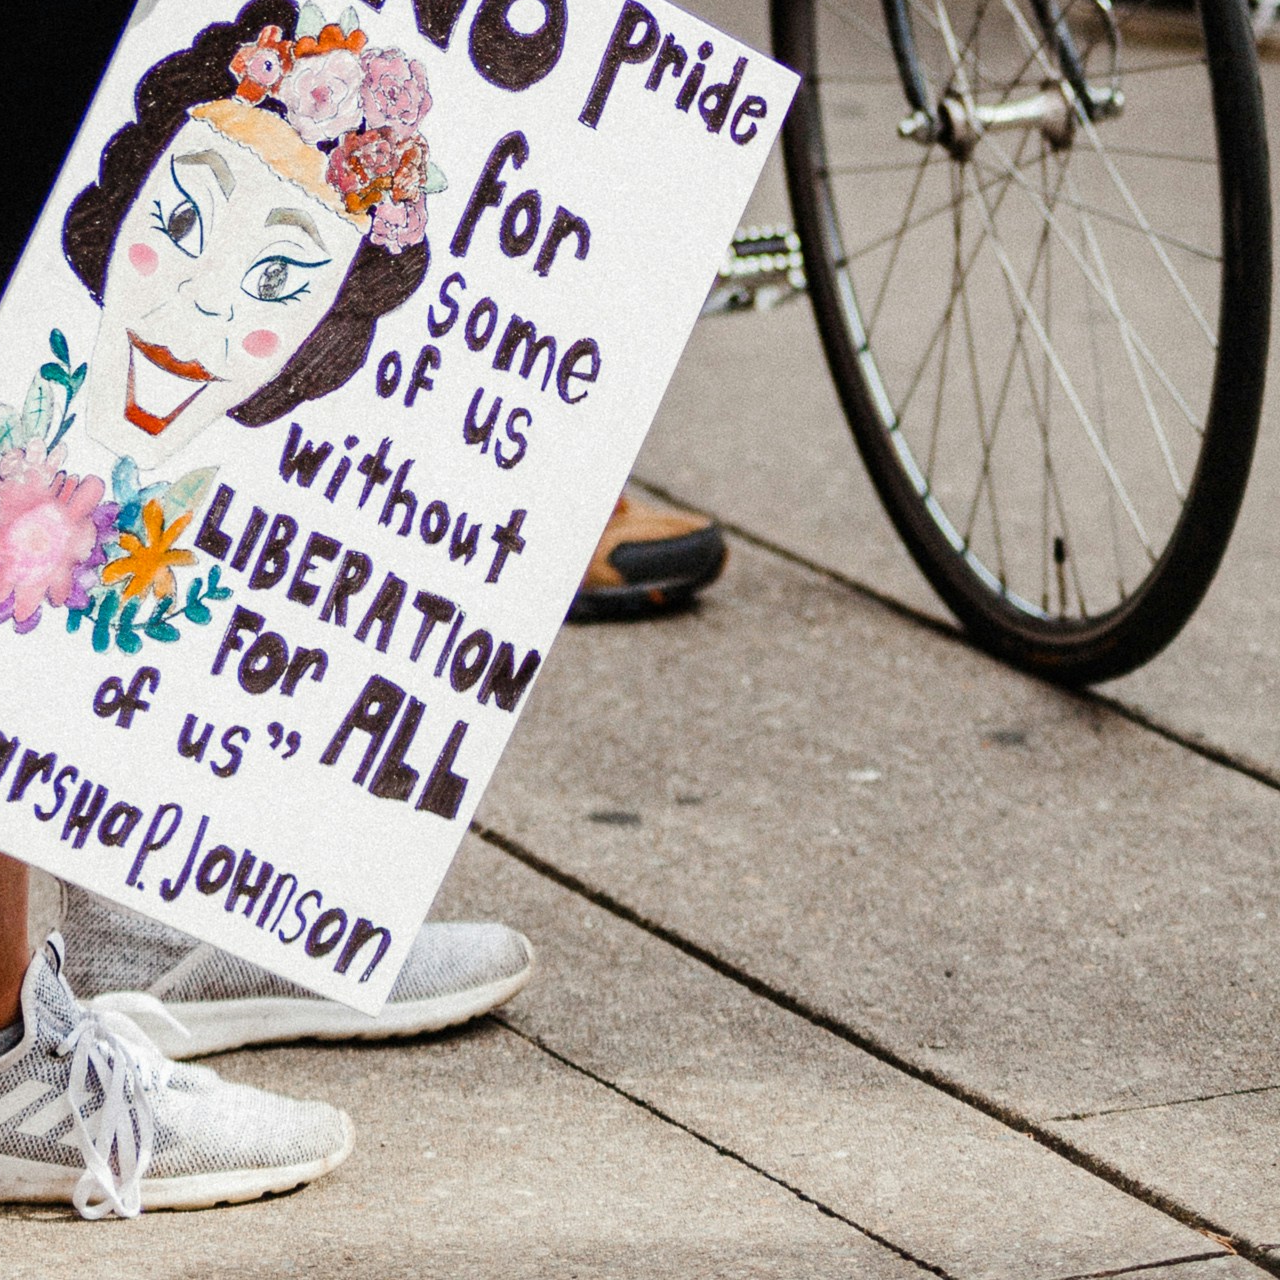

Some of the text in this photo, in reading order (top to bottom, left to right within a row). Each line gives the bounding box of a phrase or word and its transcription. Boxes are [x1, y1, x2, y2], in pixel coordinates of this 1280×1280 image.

[450, 130, 592, 278] for
[375, 344, 533, 470] of us
[427, 271, 602, 405] some
[278, 422, 527, 584] without
[193, 483, 542, 713] LIBERATION
[92, 666, 161, 729] of
[319, 674, 469, 821] ALL
